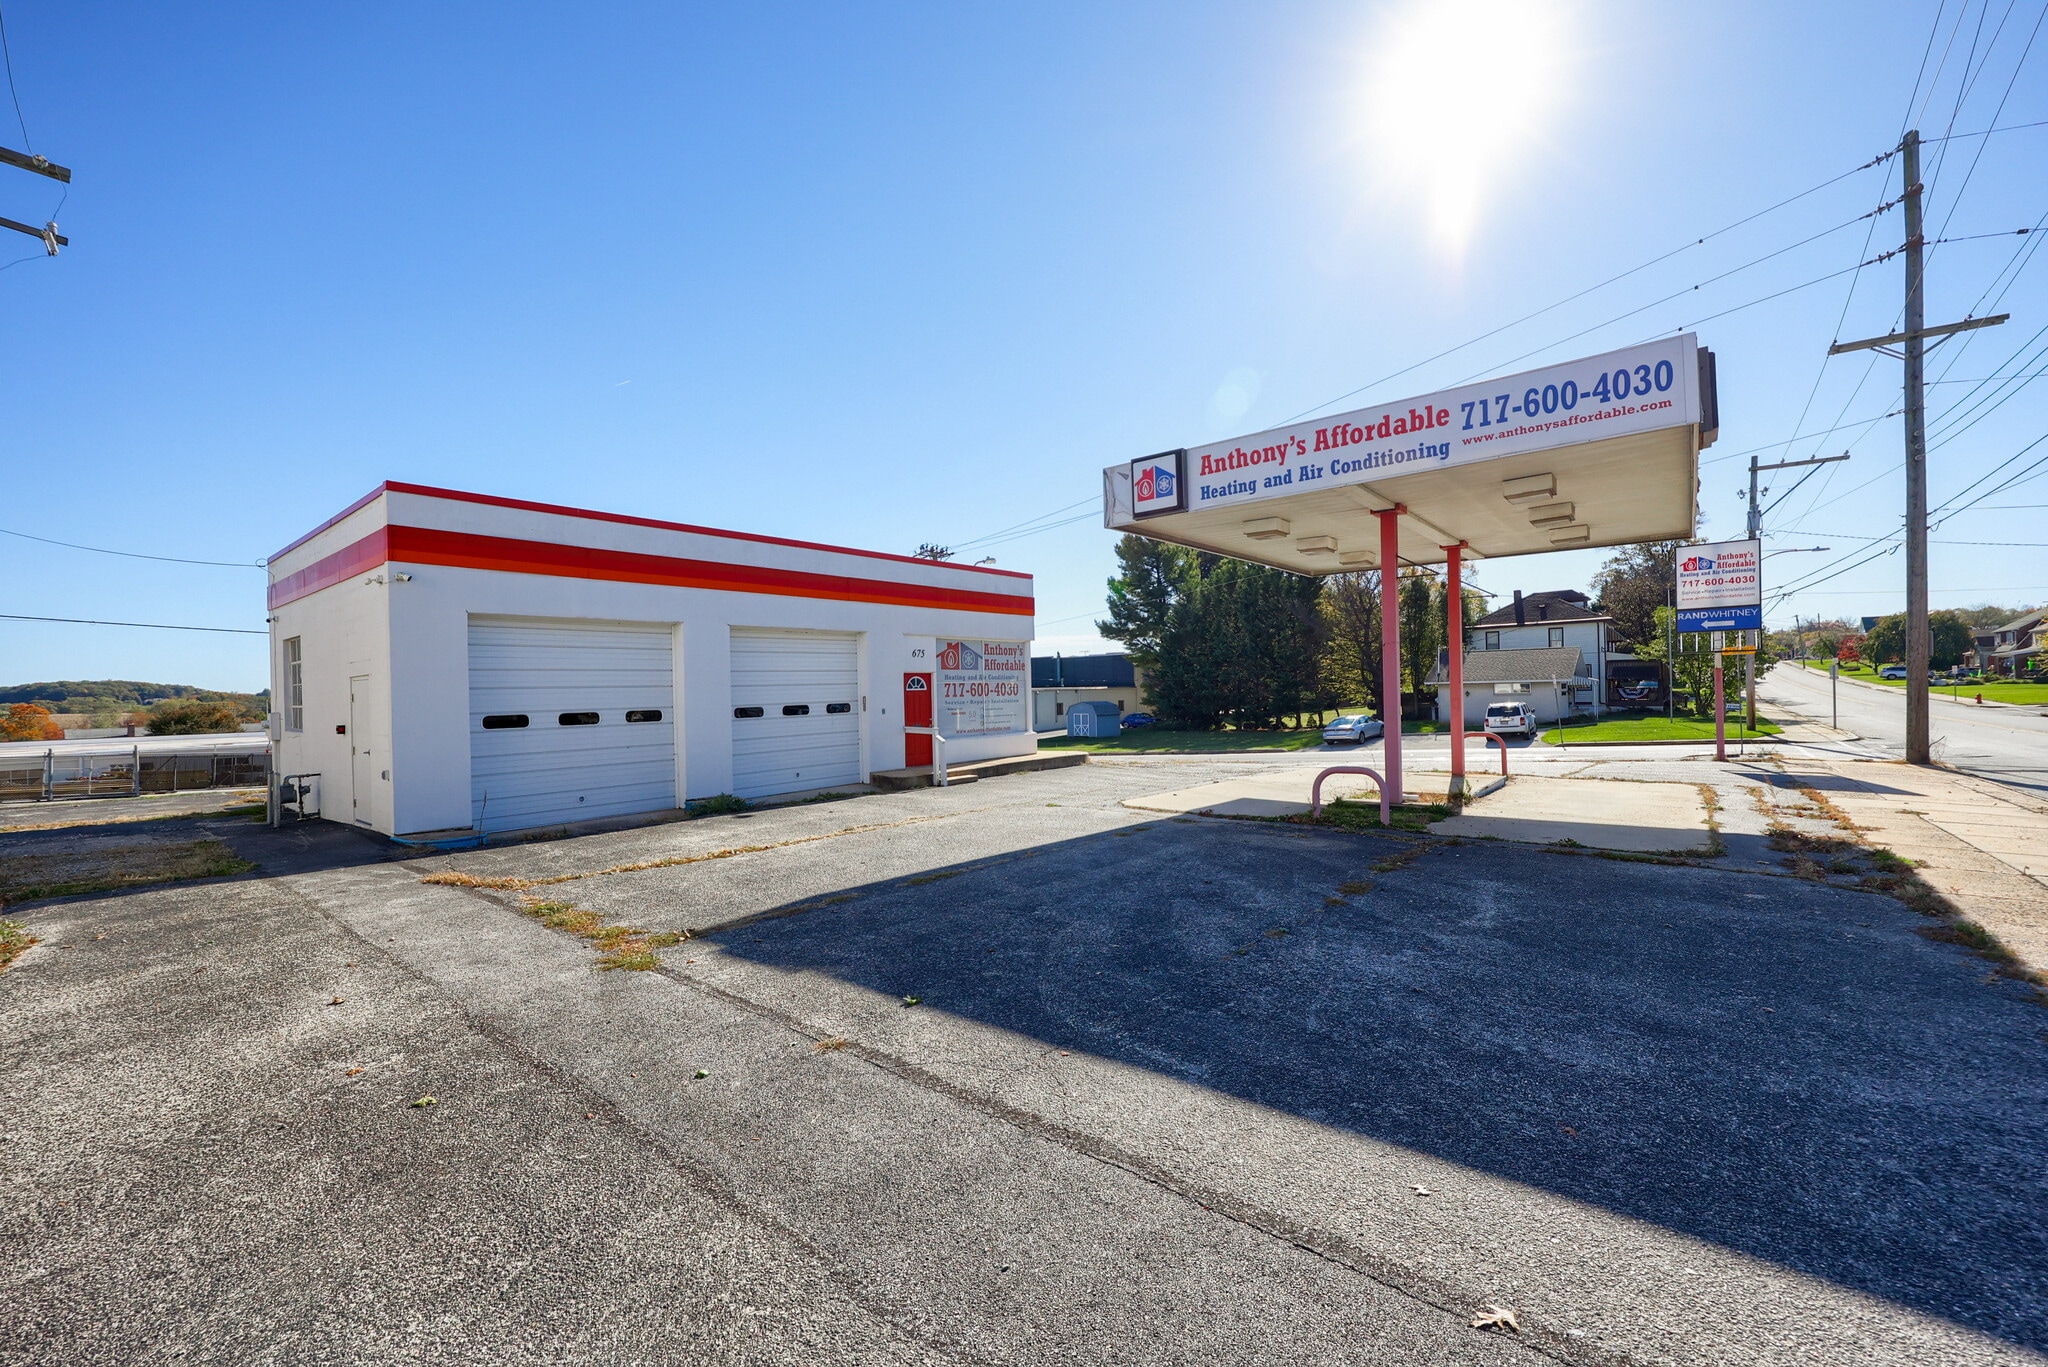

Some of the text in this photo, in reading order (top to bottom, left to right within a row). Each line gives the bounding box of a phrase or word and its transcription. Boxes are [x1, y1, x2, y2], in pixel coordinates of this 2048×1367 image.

[1200, 360, 1674, 476] Anthony's Affordable 717-600-4030
[1462, 399, 1673, 446] www.anthonysaffordable.com
[1200, 441, 1450, 501] Heating and Air Conditioning
[1717, 551, 1754, 561] Anthony's
[1717, 560, 1756, 569] Affordable
[1722, 567, 1756, 575] Conditioning
[1682, 575, 1755, 588] 717-600-4030
[1678, 608, 1758, 620] RANDWHITNEY
[911, 649, 925, 658] 675
[984, 643, 1024, 659] Anthony's
[984, 658, 1025, 671] Affordable
[944, 682, 1019, 697] 717-600-4030
